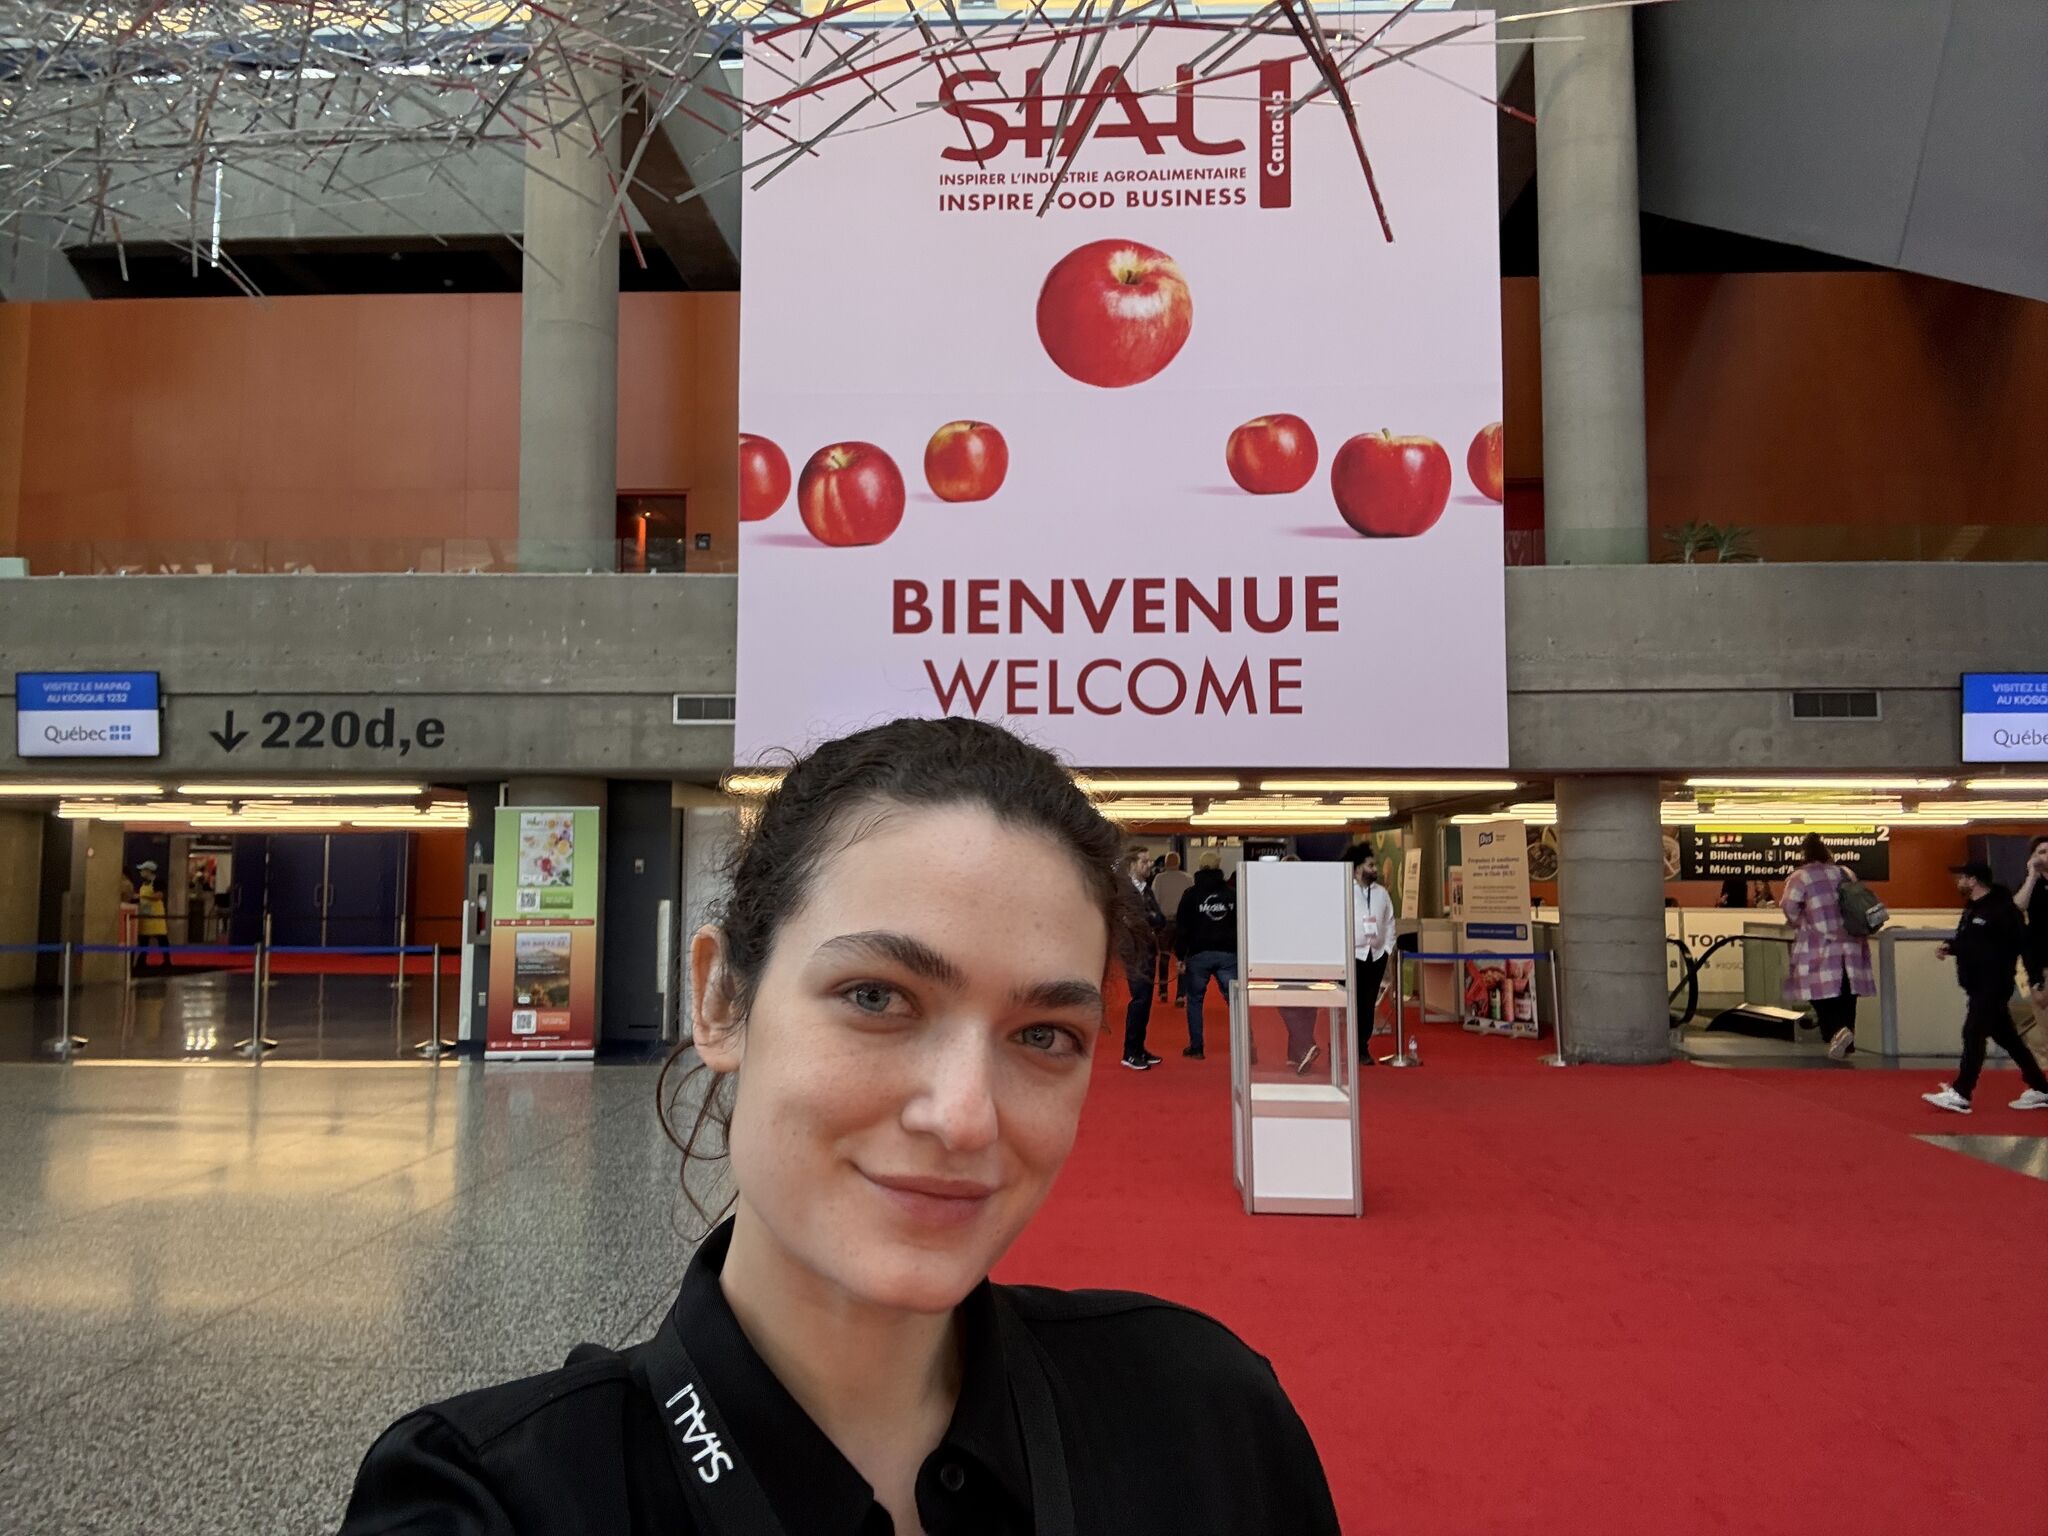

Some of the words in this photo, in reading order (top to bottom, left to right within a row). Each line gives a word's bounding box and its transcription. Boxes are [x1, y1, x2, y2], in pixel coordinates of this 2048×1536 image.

[938, 64, 1246, 162] SIAL
[1265, 90, 1285, 177] Canada
[939, 173, 1006, 186] INSPIRER
[1011, 171, 1099, 184] L'INDUSTRIE
[1103, 167, 1247, 183] AGROALIMENTAIRE
[939, 193, 1034, 212] INSPIRE
[1126, 187, 1247, 208] BUSINESS
[892, 575, 1340, 635] BIENVENUE
[42, 682, 79, 692] VISITEZ
[81, 682, 92, 691] LE
[922, 655, 1303, 717] WELCOME
[1992, 683, 2034, 693] VISITEZ
[47, 693, 60, 703] AU
[62, 693, 104, 703] KIOSQUE
[1996, 695, 2012, 705] AU
[44, 725, 107, 744] Québec
[260, 707, 446, 757] 220d,e
[1876, 825, 1890, 841] 2
[1709, 850, 1762, 861] Billetterie
[1709, 864, 1741, 875] Métro
[1743, 864, 1795, 875] Place-d'A
